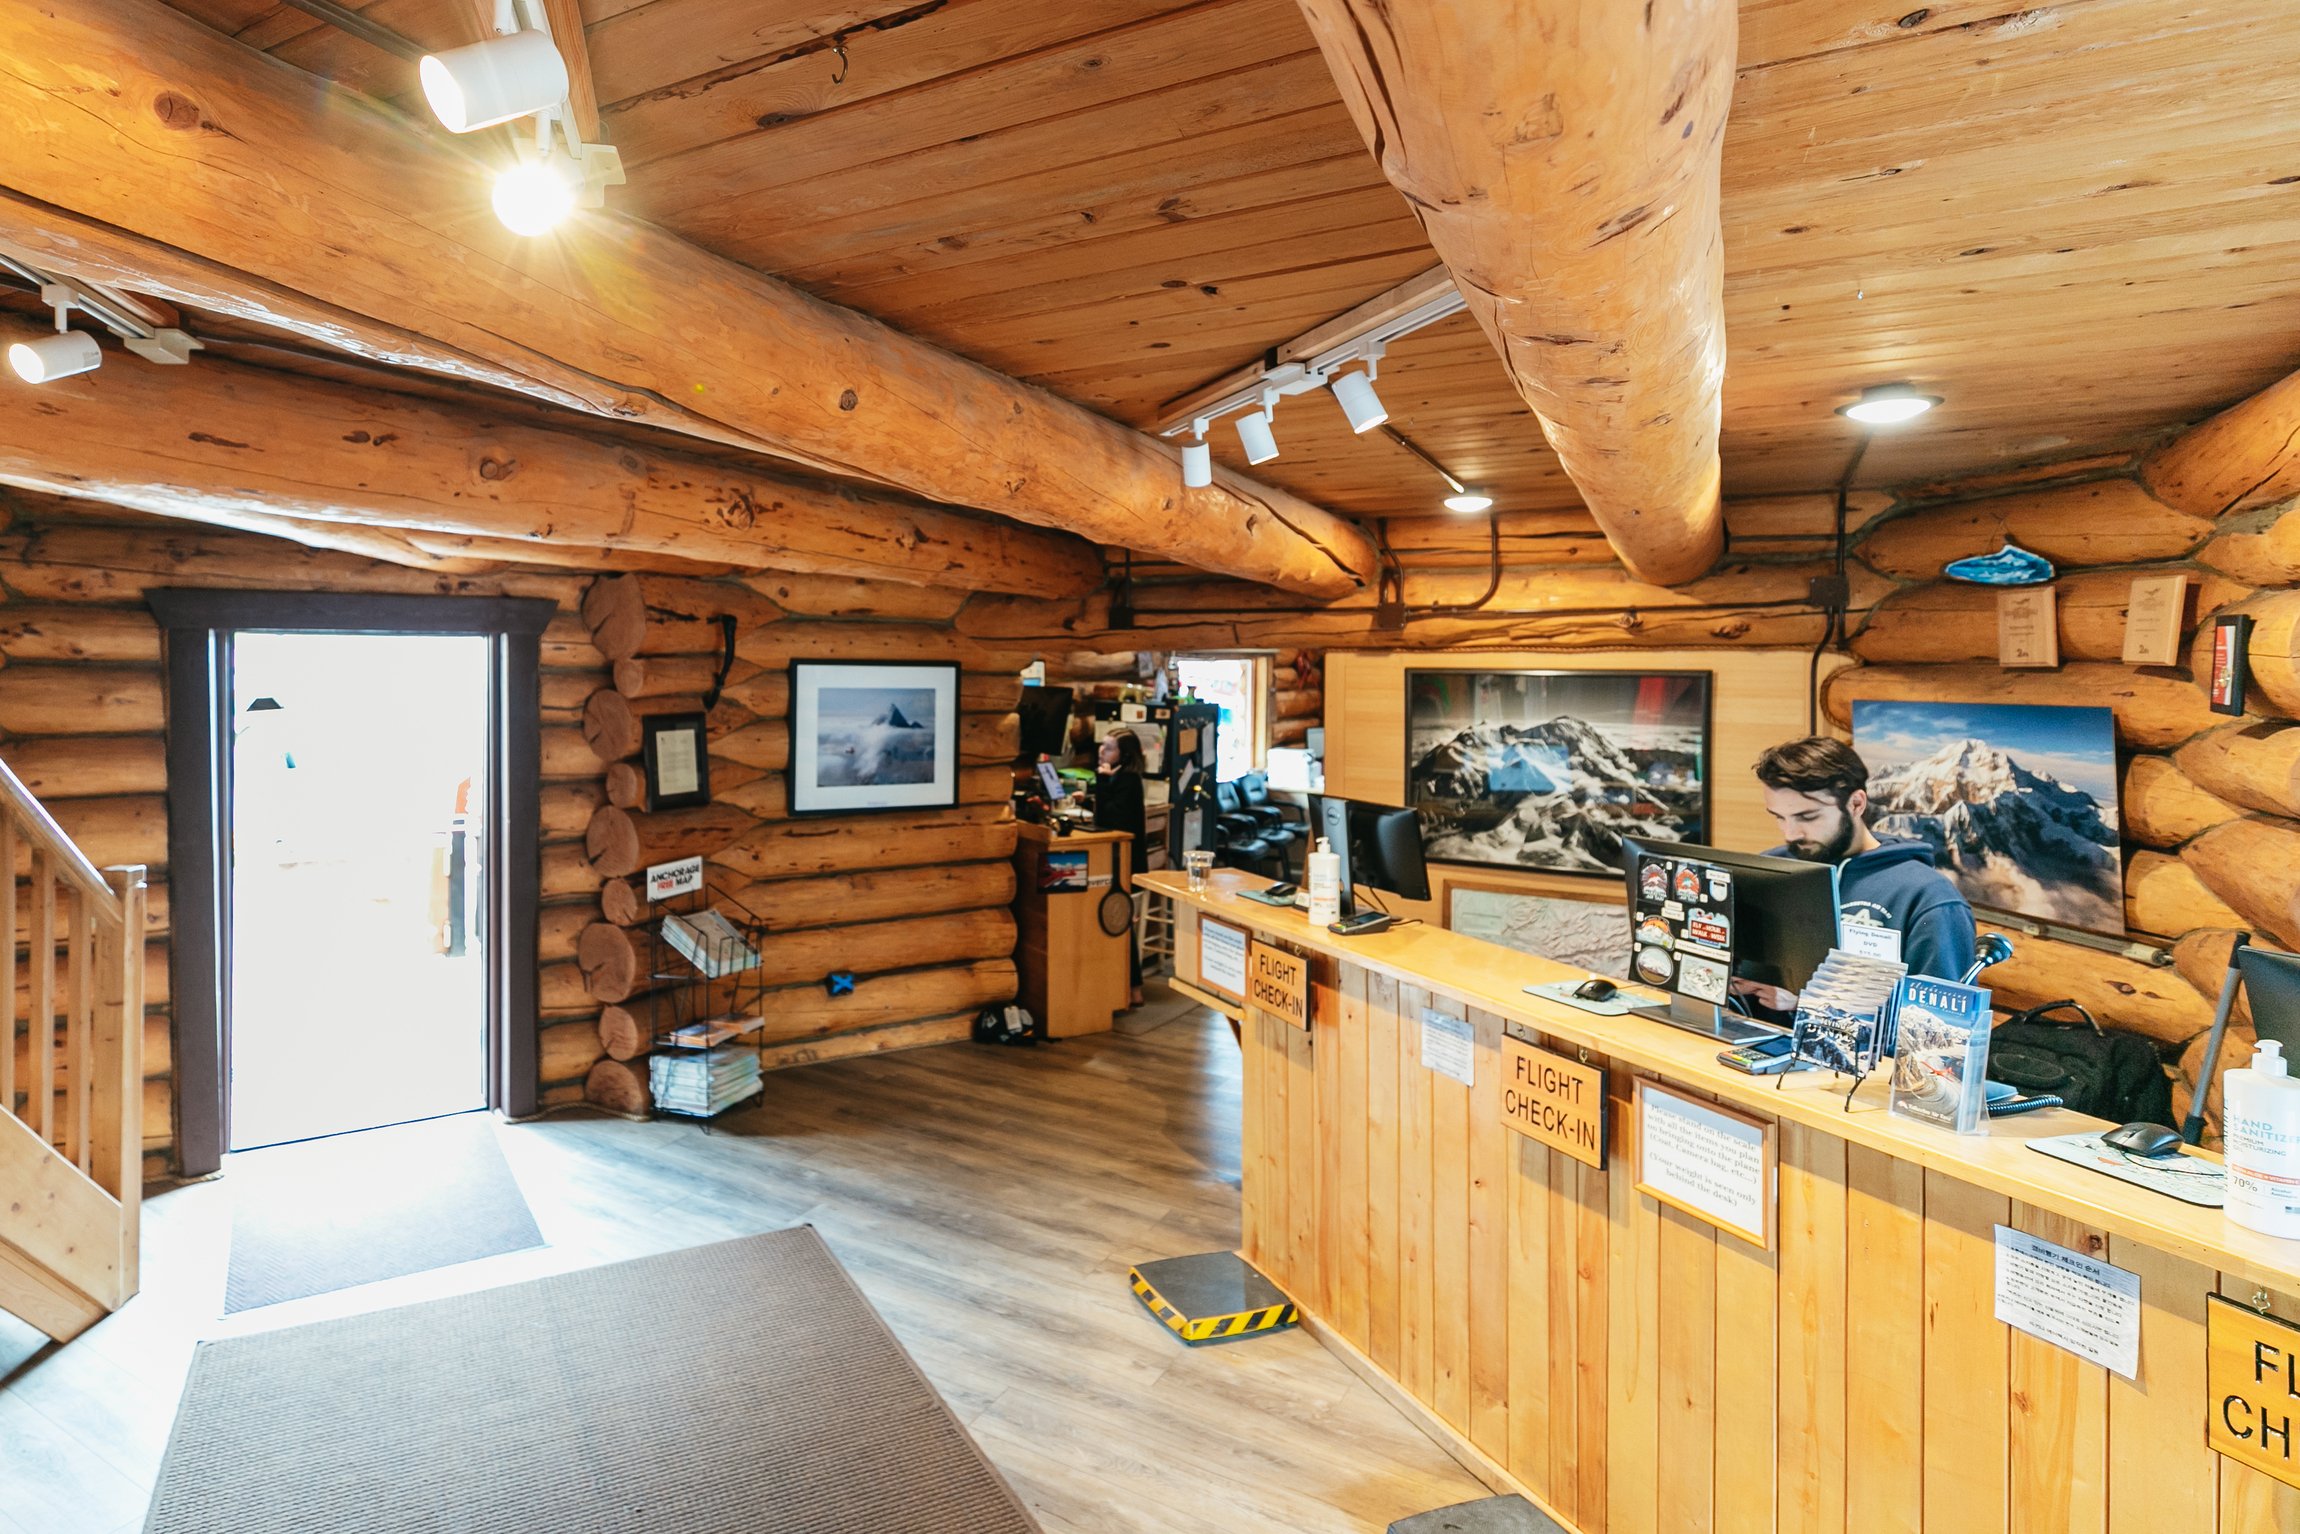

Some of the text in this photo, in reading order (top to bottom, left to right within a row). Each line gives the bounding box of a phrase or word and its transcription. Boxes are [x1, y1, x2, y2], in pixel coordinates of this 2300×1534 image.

[650, 864, 700, 883] ANCHORAGE
[675, 874, 693, 885] MAP
[1849, 928, 1868, 937] Flying
[1259, 954, 1297, 986] FLIGHT
[1254, 979, 1303, 1018] CHECK-IN
[1908, 988, 1967, 1014] DENALI
[1516, 1055, 1584, 1104] FLIGHT
[1505, 1089, 1595, 1151] CHECK-IN
[1651, 1104, 1756, 1151] Please stand on the scale
[2233, 1114, 2273, 1131] HAND
[1647, 1113, 1760, 1164] with all the items you plan
[1647, 1123, 1760, 1173] on bringing onto the plane
[1676, 1142, 1709, 1162] Camera
[2233, 1133, 2264, 1146] PREMIUM
[2233, 1139, 2287, 1156] MOISTURIZING
[1649, 1151, 1756, 1205] (Your weight is seen only
[1665, 1168, 1738, 1207] behind the desk)
[2233, 1176, 2258, 1192] 70%
[2062, 1255, 2084, 1269] 체크인
[2085, 1264, 2100, 1276] 순서
[2254, 1339, 2300, 1399] FL
[2222, 1394, 2290, 1460] CH
